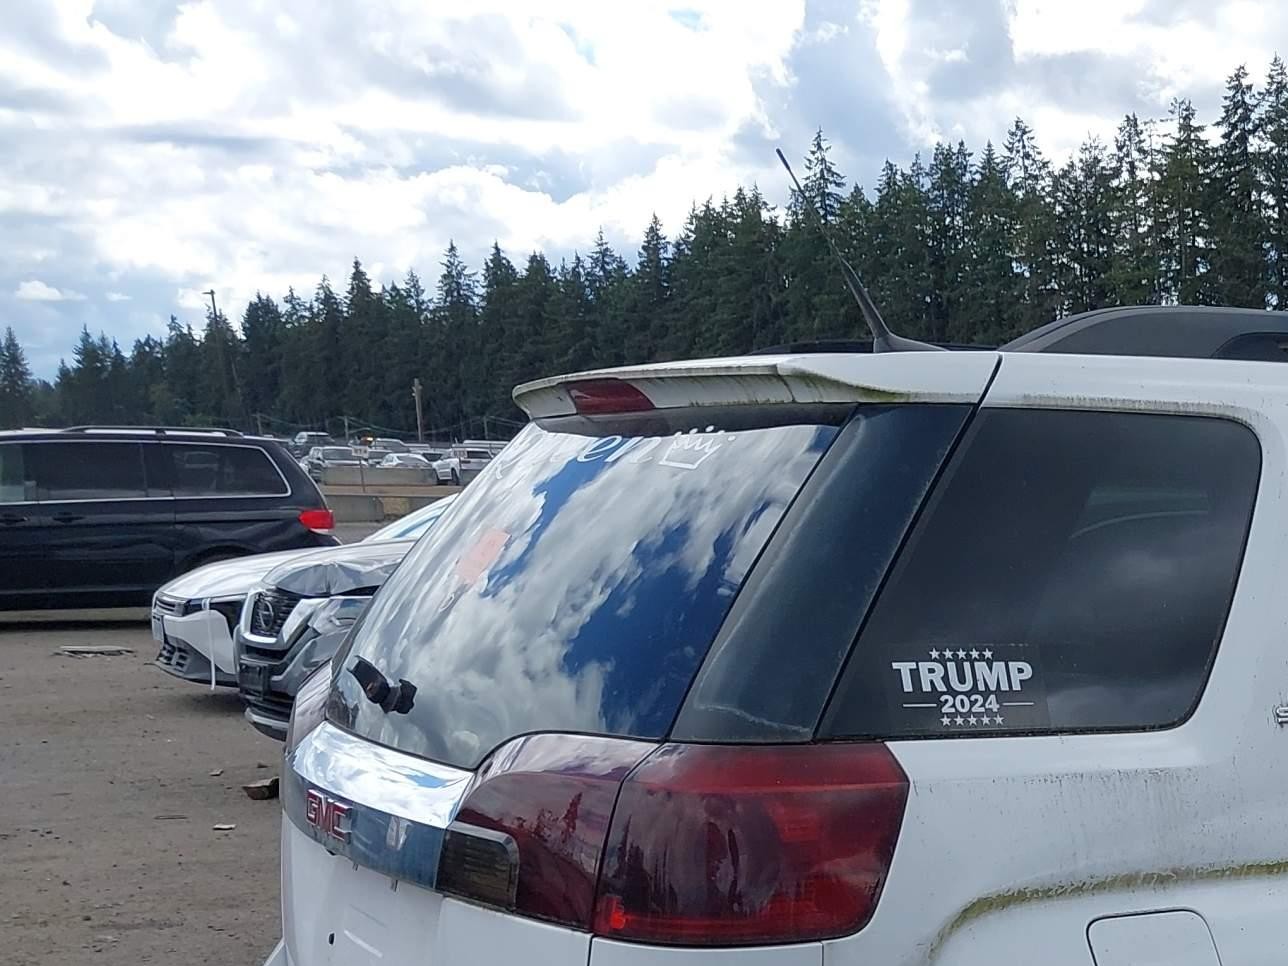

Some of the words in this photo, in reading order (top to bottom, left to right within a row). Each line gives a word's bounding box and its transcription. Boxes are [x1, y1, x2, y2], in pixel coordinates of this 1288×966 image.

[891, 661, 1033, 692] TRUMP
[939, 694, 1000, 713] 2024
[306, 789, 352, 844] GMC
